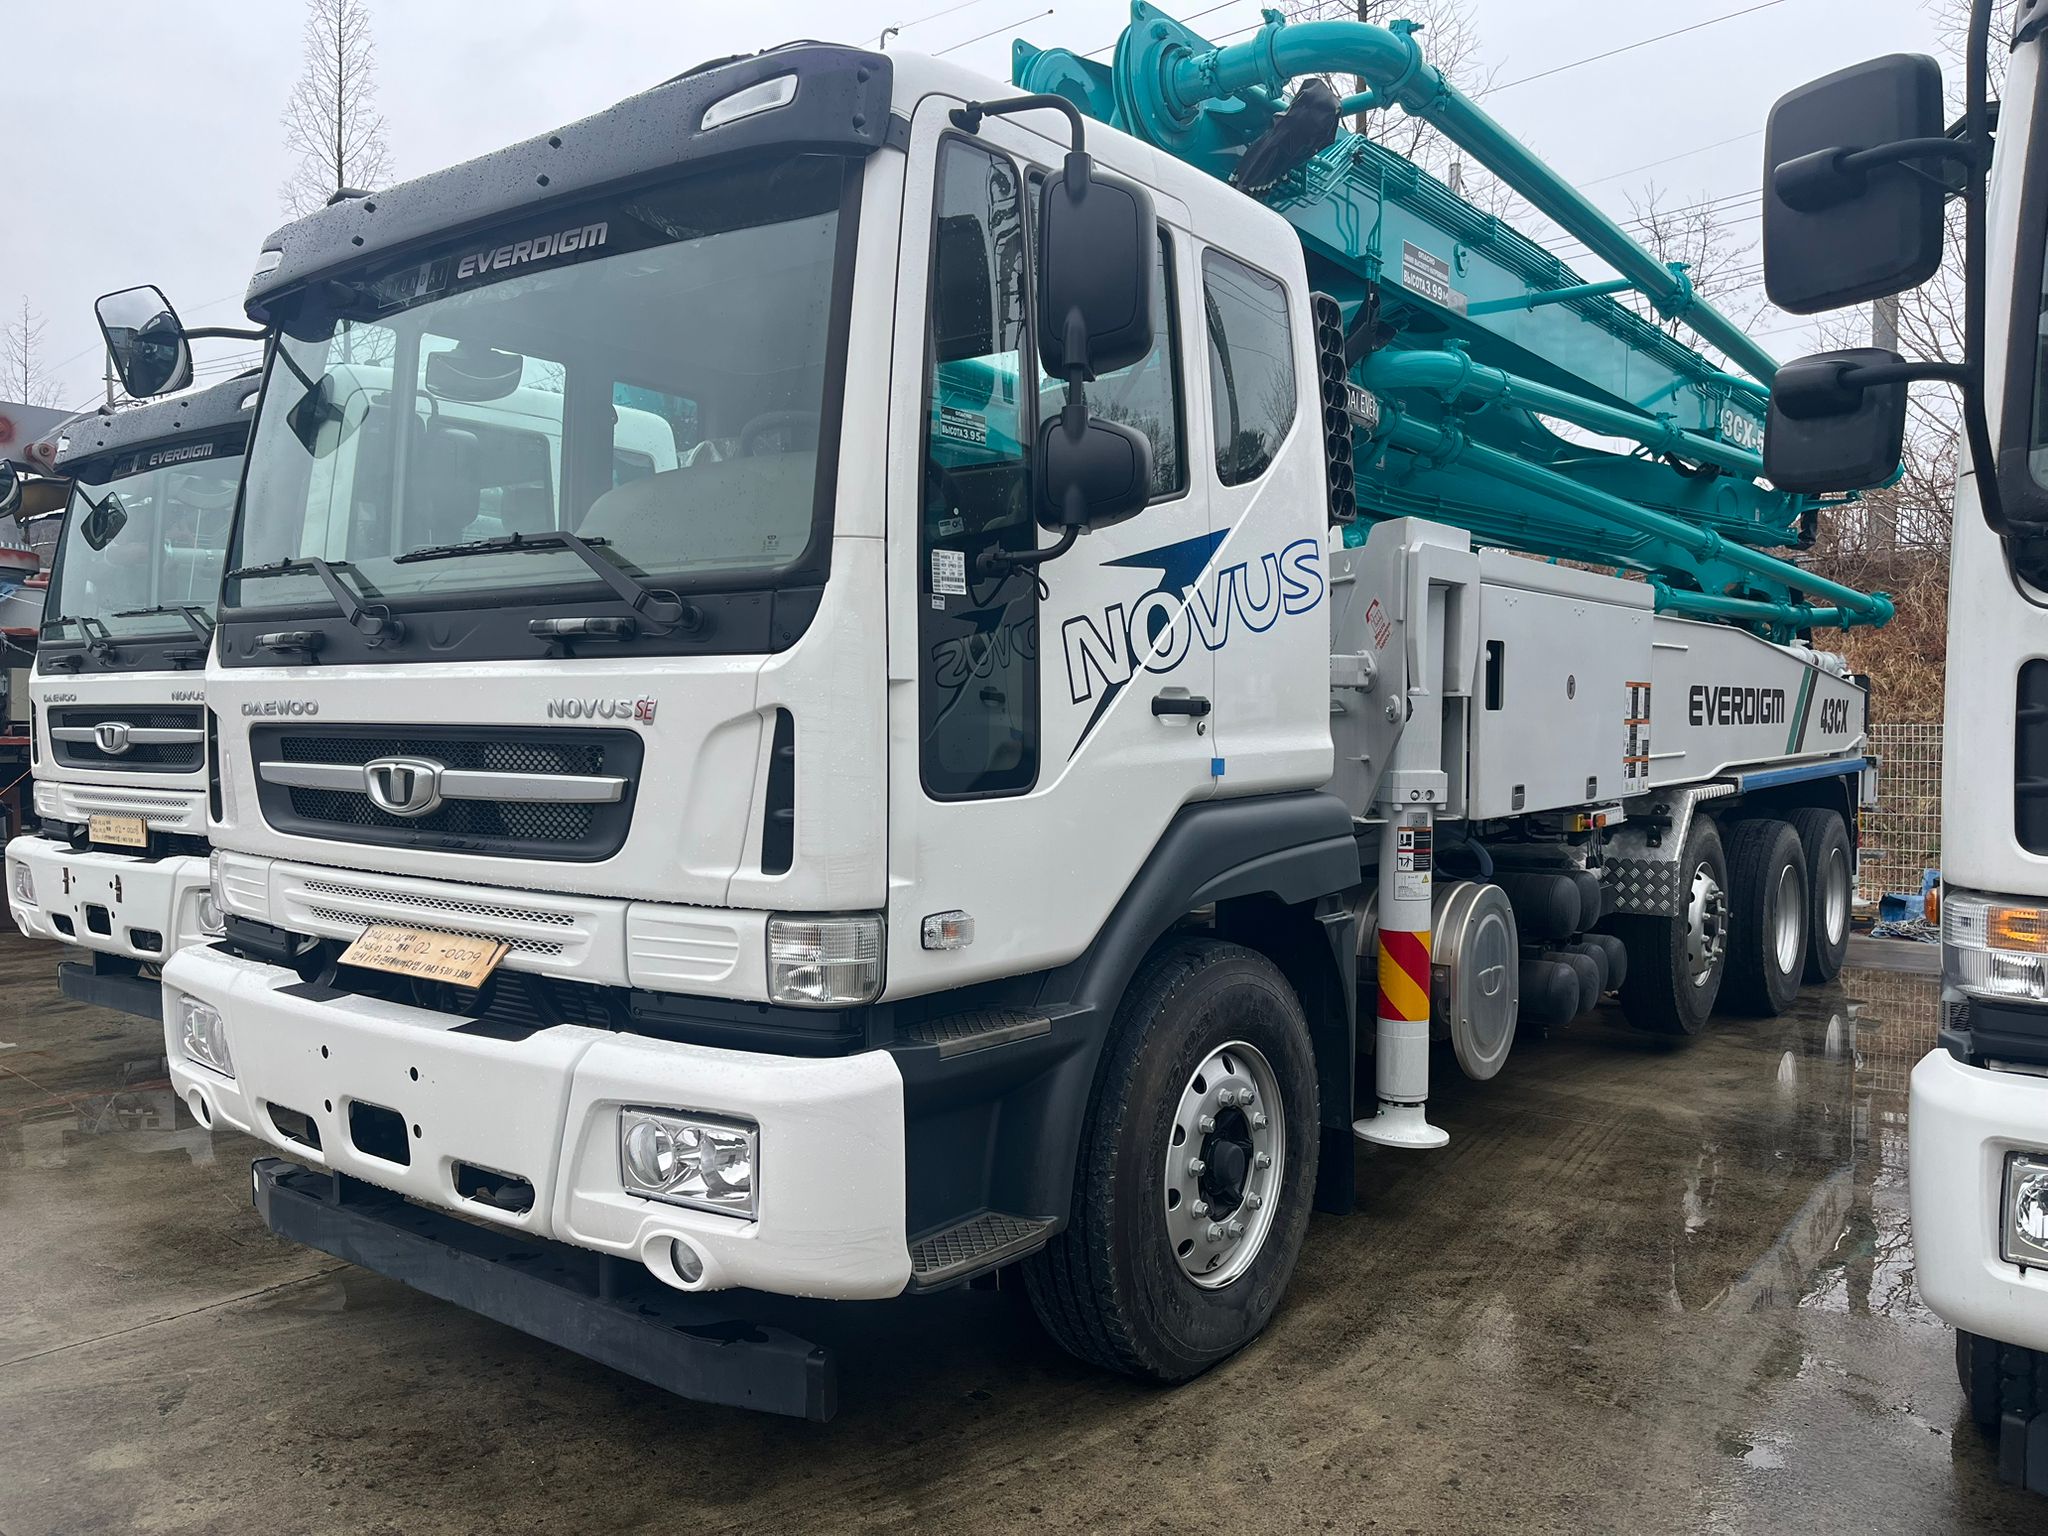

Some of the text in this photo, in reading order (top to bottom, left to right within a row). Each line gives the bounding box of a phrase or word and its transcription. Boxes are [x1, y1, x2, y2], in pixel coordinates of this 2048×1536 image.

[457, 222, 609, 279] EVERDIGM
[149, 443, 214, 466] EVERDIGM
[1061, 538, 1325, 705] NOVUS
[43, 693, 78, 703] DAEWOO
[241, 700, 319, 716] DAEWOO
[547, 698, 633, 719] NOVUS
[1688, 685, 1785, 726] EVERDIGM
[1820, 698, 1850, 735] 43CX
[413, 942, 431, 955] 02
